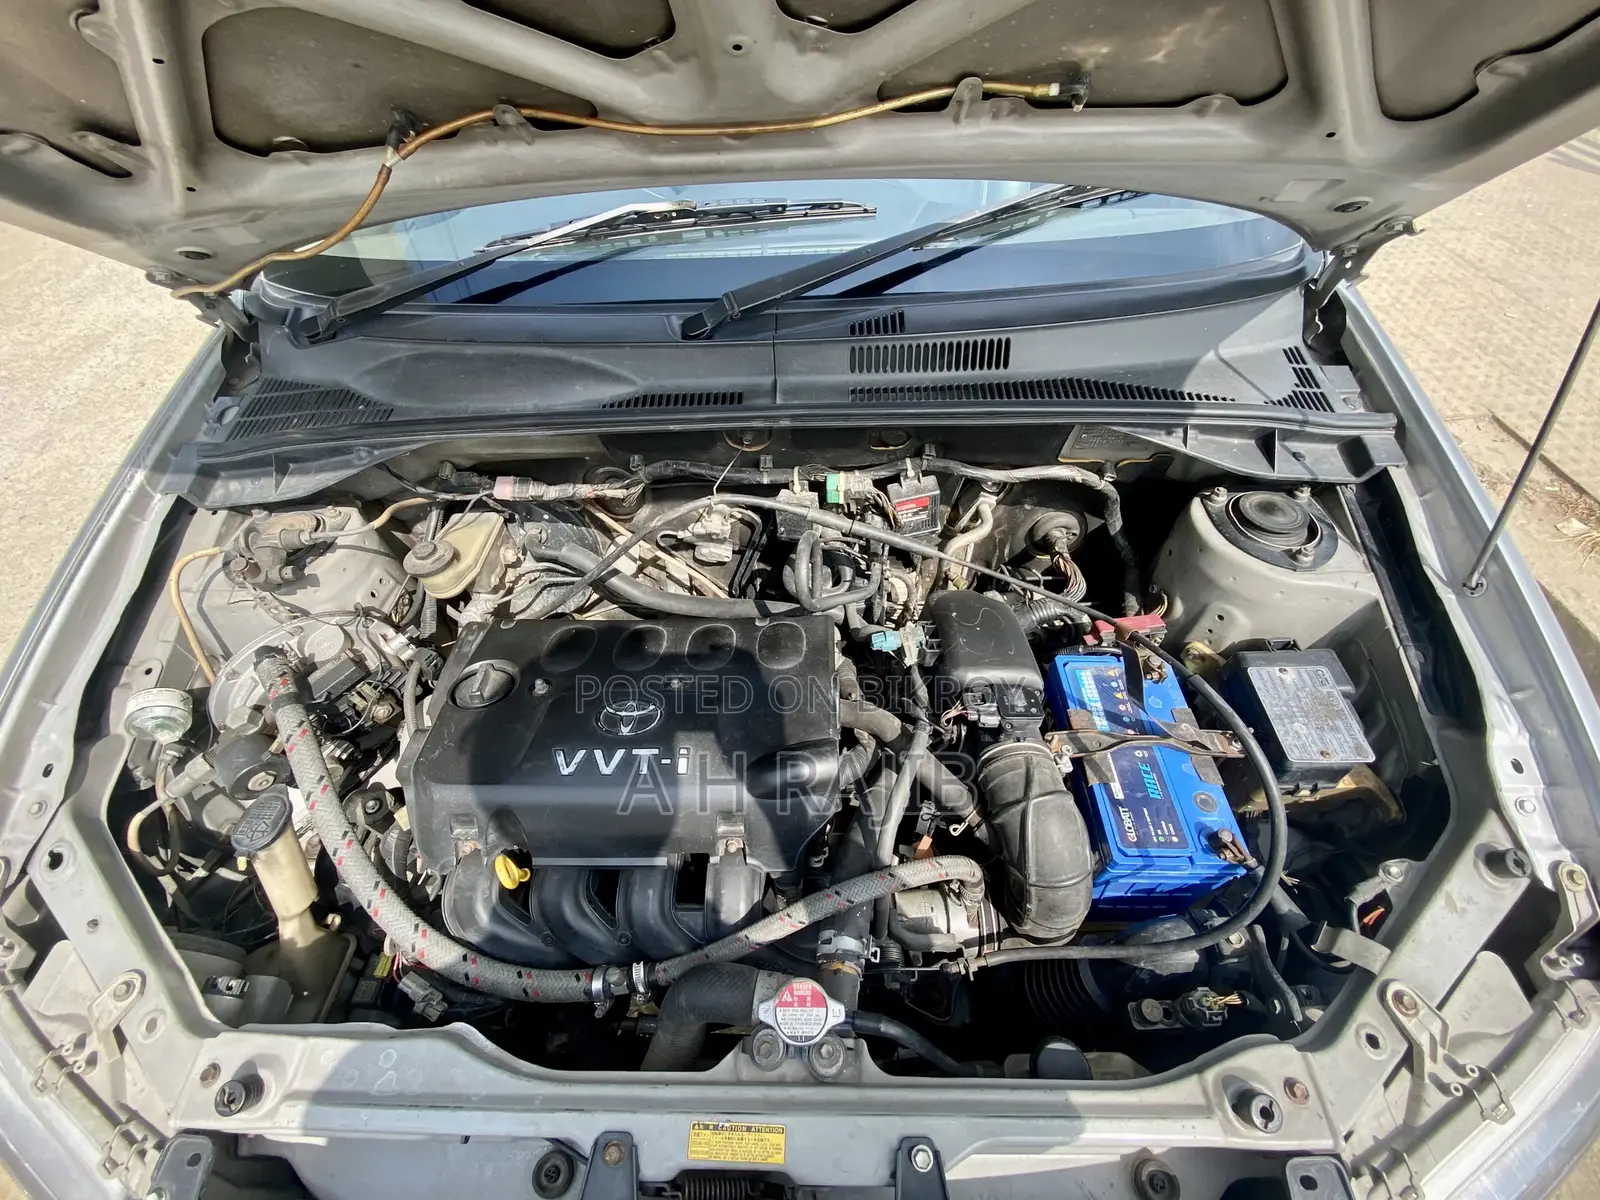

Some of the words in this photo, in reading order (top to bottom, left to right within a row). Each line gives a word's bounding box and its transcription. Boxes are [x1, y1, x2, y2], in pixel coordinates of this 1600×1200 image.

[552, 746, 691, 776] VVT-i
[1118, 805, 1138, 843] GLOBATT
[718, 1124, 747, 1132] CAUTION
[751, 1126, 783, 1134] ATTENTION
